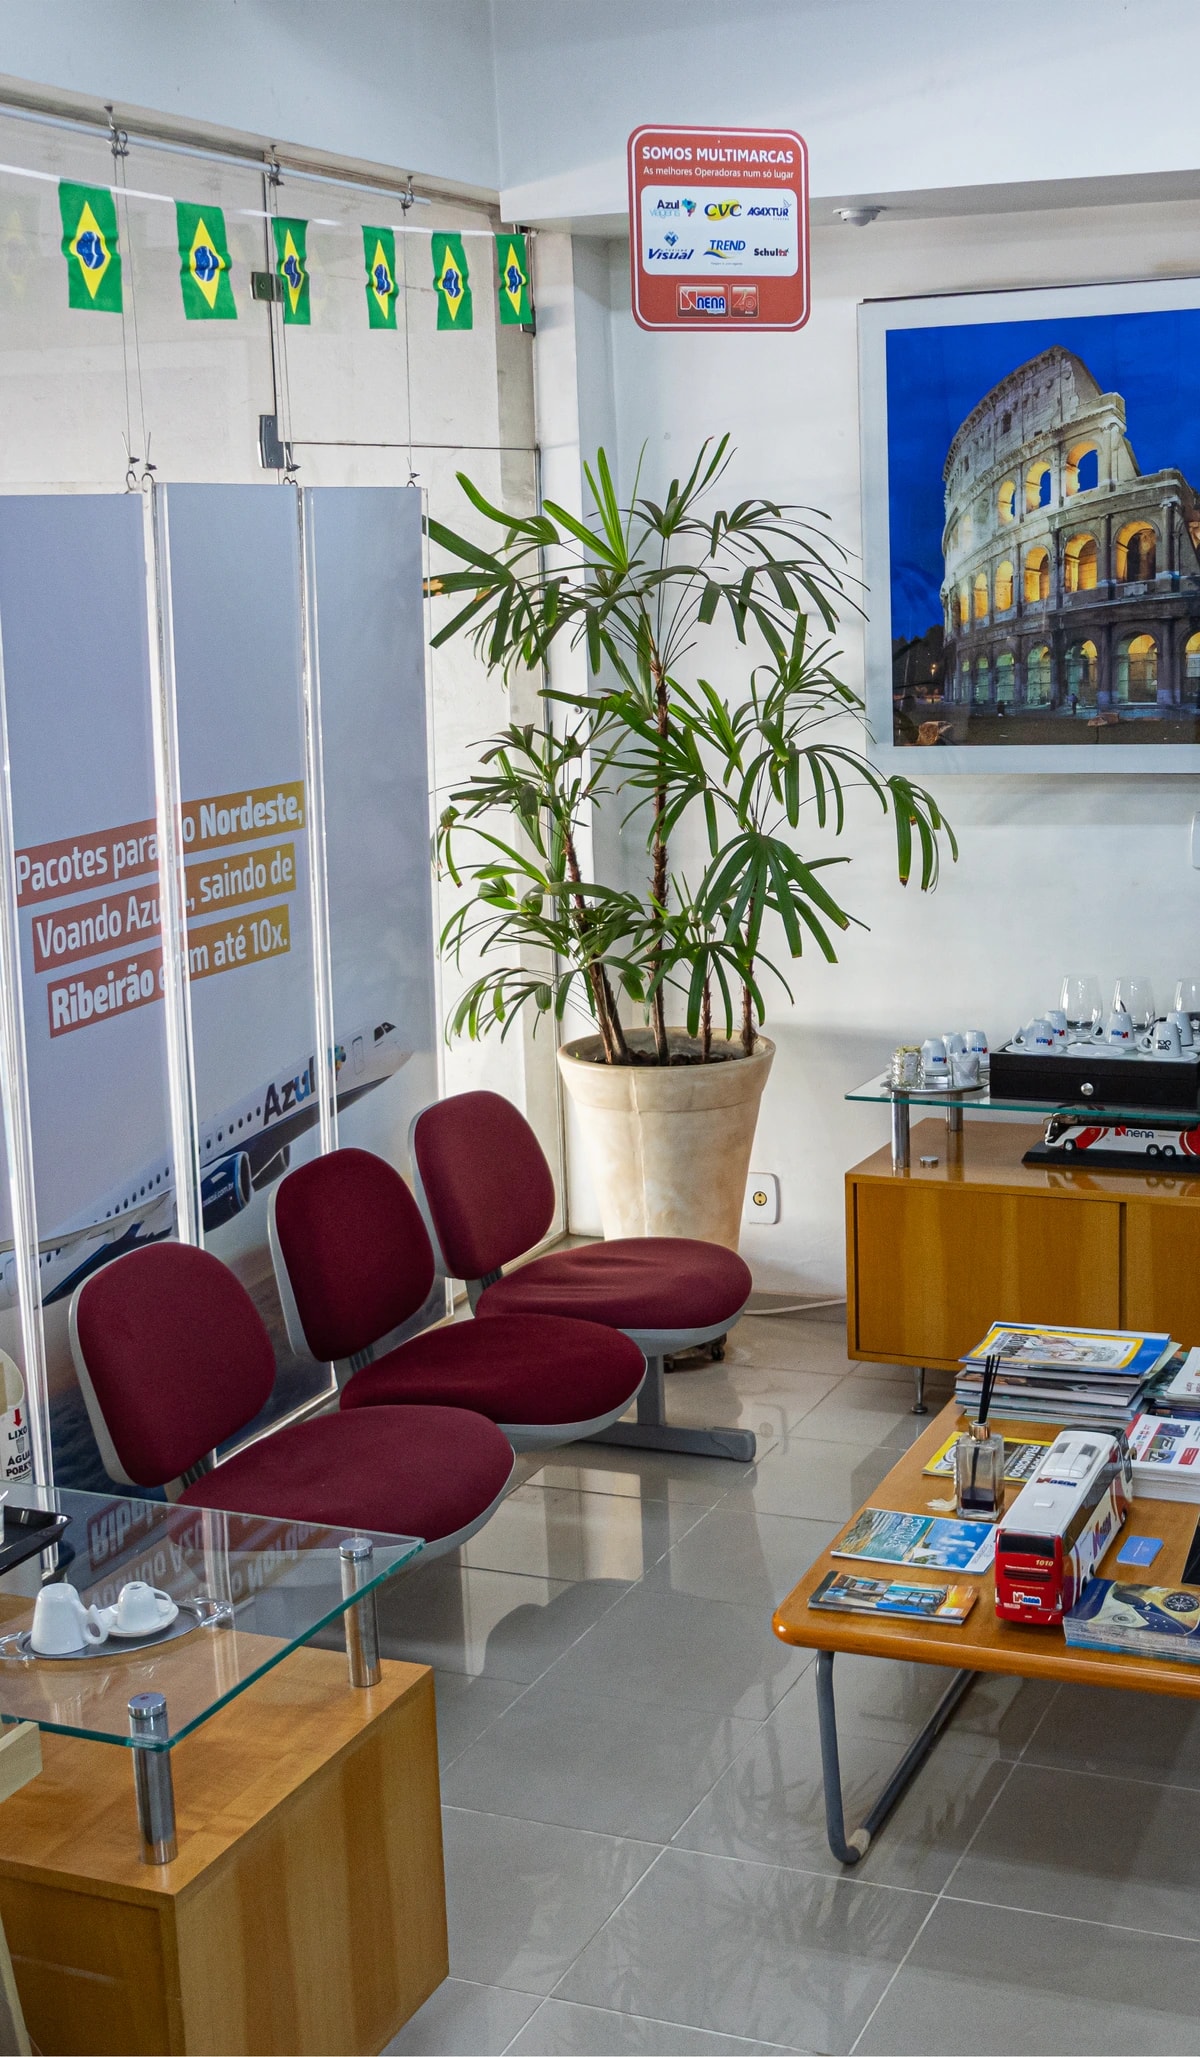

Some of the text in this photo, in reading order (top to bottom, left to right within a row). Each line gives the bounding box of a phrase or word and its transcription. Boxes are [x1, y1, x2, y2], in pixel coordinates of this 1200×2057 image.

[642, 146, 794, 164] SOMOS MULTIMARCAS
[643, 166, 794, 181] As melhores Operadoras num só lugar
[657, 199, 680, 210] Azul
[704, 203, 743, 217] CVC
[747, 206, 789, 217] AGAXTUR
[709, 239, 746, 251] TREND
[648, 248, 695, 260] Visual
[16, 792, 303, 895] Pacotes para o Nordeste,
[36, 903, 121, 958] Voando
[200, 856, 266, 903] saindo
[271, 850, 293, 884] de
[51, 962, 154, 1030] Ribeirão
[214, 924, 247, 967] até
[250, 918, 288, 955] 10x.
[263, 1055, 316, 1126] Azul
[8, 1425, 28, 1441] LIXO
[1009, 1445, 1041, 1477] FRANCISCO
[1035, 1559, 1054, 1567] 1010
